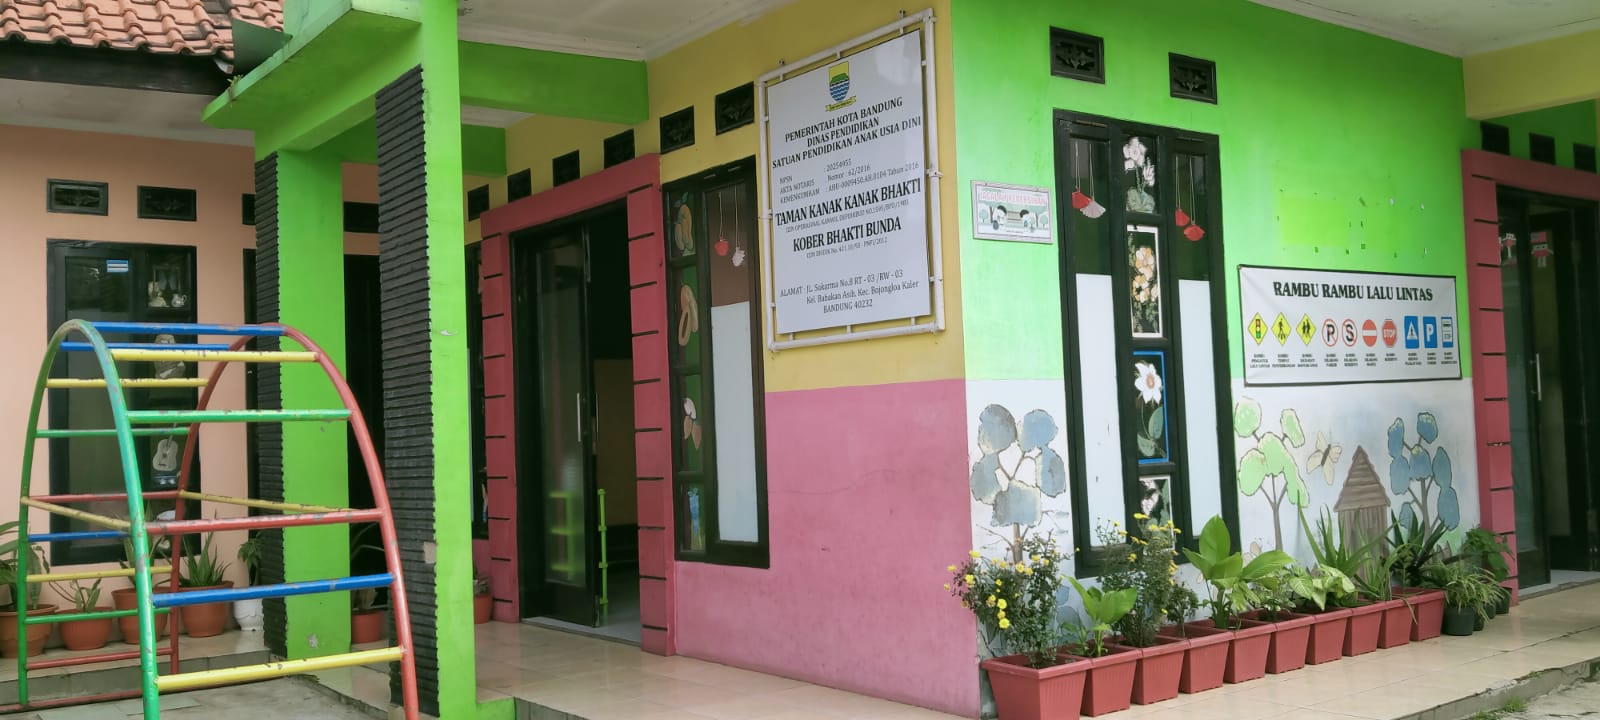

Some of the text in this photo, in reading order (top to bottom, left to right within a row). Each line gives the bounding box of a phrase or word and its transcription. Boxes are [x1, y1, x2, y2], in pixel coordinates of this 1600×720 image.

[785, 96, 903, 143] PEMERINTAH KOTA BANDUNG
[807, 116, 880, 147] DINAS PENDIDIKAN
[772, 116, 921, 169] SATUAN PENDIDIKAN ANAK USIA DINI
[827, 172, 844, 182] Nomor
[887, 167, 904, 177] Tahun
[905, 161, 919, 172] 2016
[775, 177, 921, 226] TAMAN KANAK KANAK BHAKTI
[793, 216, 901, 252] KOBER BHAKTI BUNDA
[779, 286, 802, 298] ALAMAT
[854, 276, 862, 285] RT
[867, 273, 875, 283] 03
[895, 269, 903, 279] 03
[817, 292, 841, 303] Babakan
[870, 282, 901, 295] Bojongloa
[902, 280, 919, 290] Kaler
[1273, 281, 1433, 301] RAMBU RAMBU LALU LINTAS
[823, 298, 873, 313] BANDUNG 40232
[1327, 324, 1335, 342] P
[1346, 323, 1354, 342] S
[1383, 328, 1396, 338] STOP
[1425, 323, 1434, 342] P
